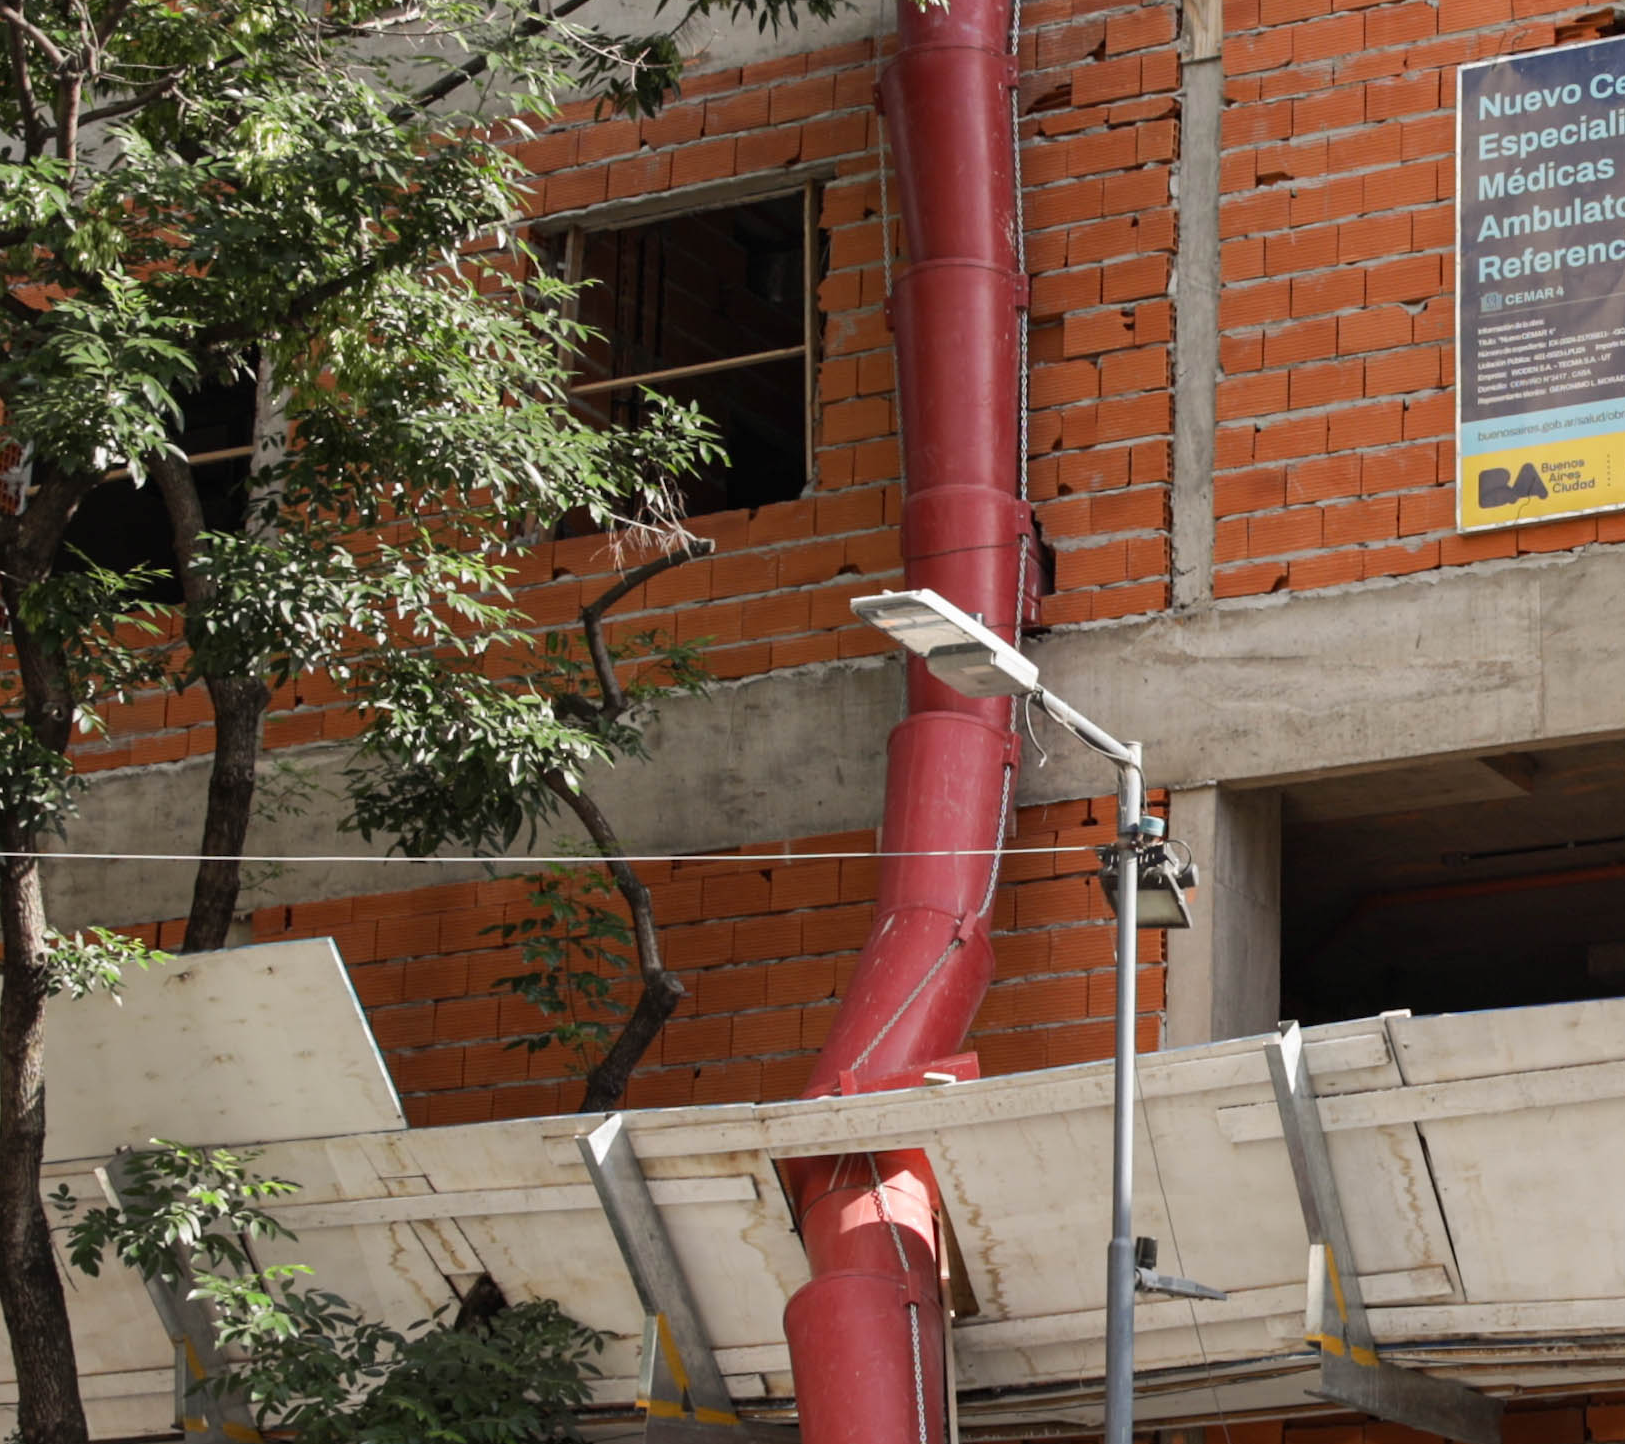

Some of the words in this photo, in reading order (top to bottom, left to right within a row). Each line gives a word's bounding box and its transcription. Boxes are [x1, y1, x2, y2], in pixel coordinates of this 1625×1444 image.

[1479, 84, 1581, 121] Nuevo
[1478, 158, 1615, 201] Médicas
[1505, 288, 1554, 305] CEMAR
[1556, 286, 1564, 296] 4
[1541, 459, 1585, 473] Buenos
[1479, 463, 1548, 508] BA
[1549, 471, 1581, 483] Aires
[1553, 479, 1595, 494] Ciudad
